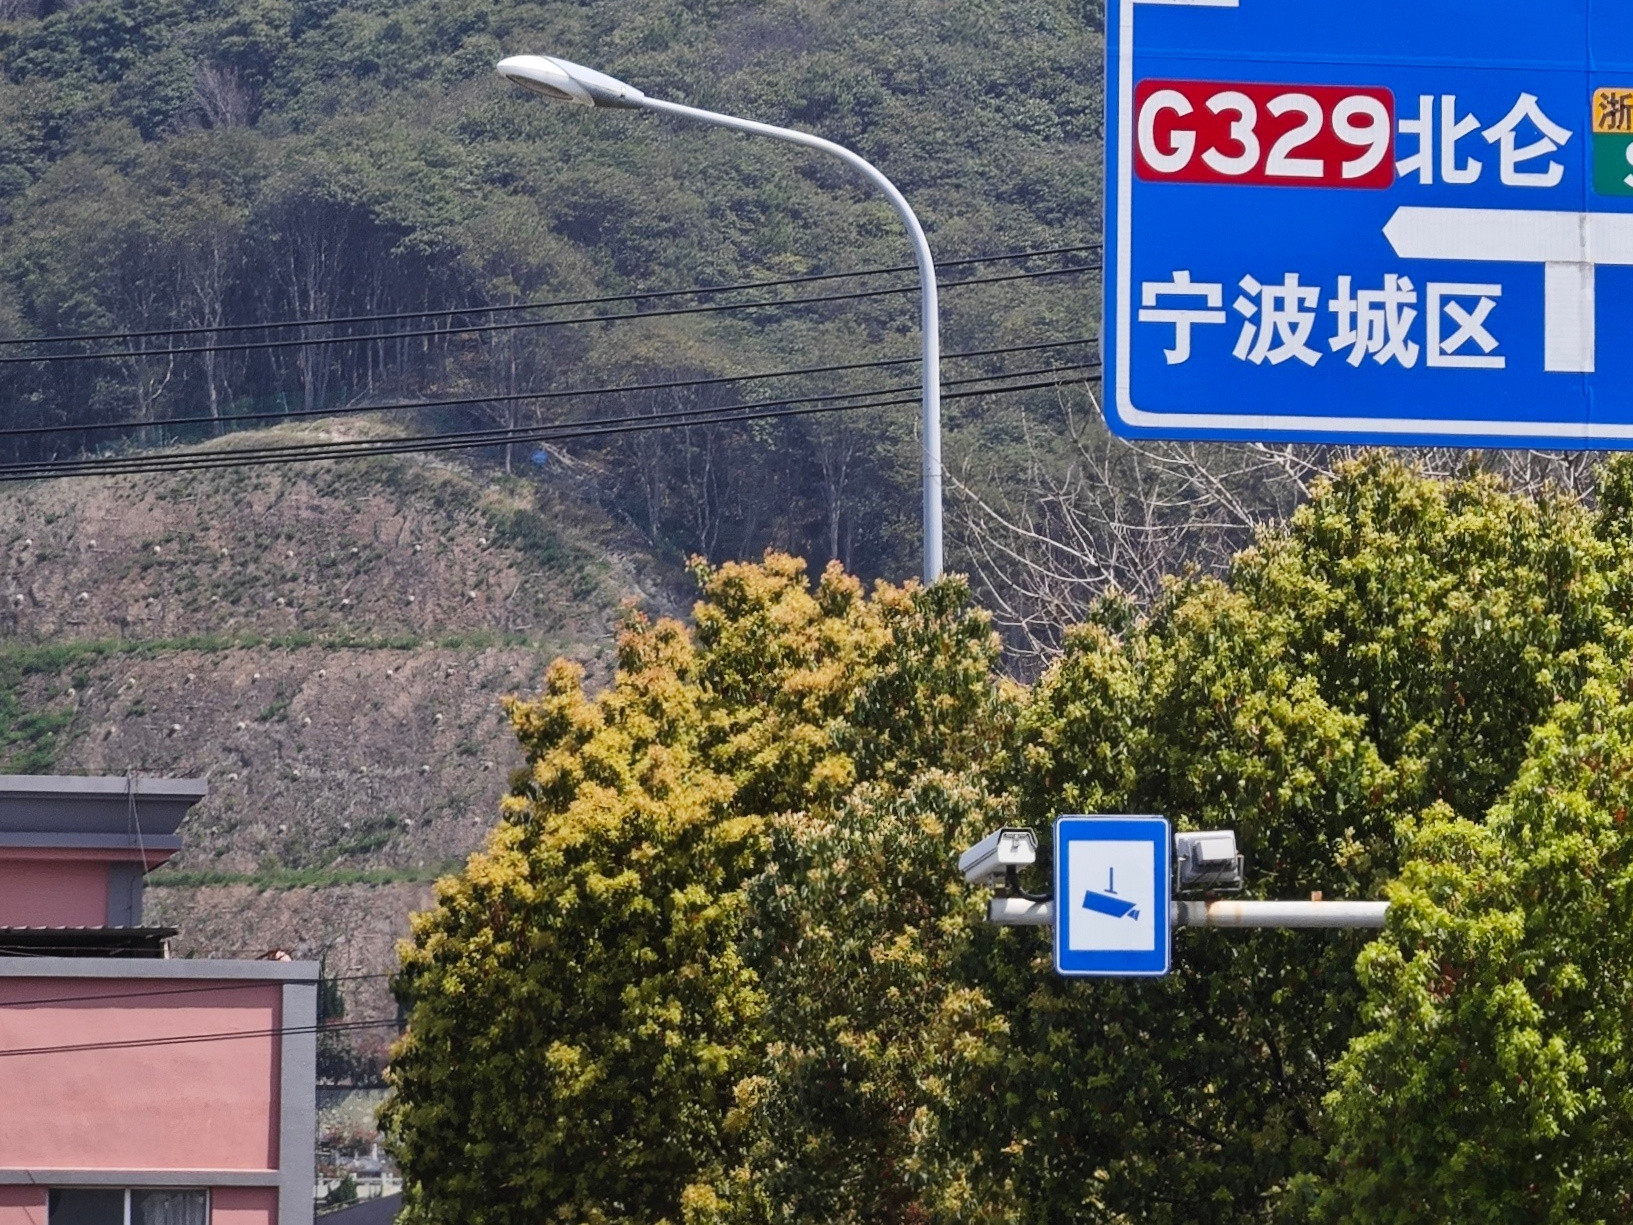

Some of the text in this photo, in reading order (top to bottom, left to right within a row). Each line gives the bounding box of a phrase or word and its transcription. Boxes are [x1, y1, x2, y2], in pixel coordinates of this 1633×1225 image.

[1136, 88, 1391, 180] G329
[1396, 91, 1574, 189] 北仑
[1137, 269, 1507, 371] 宁波城区
